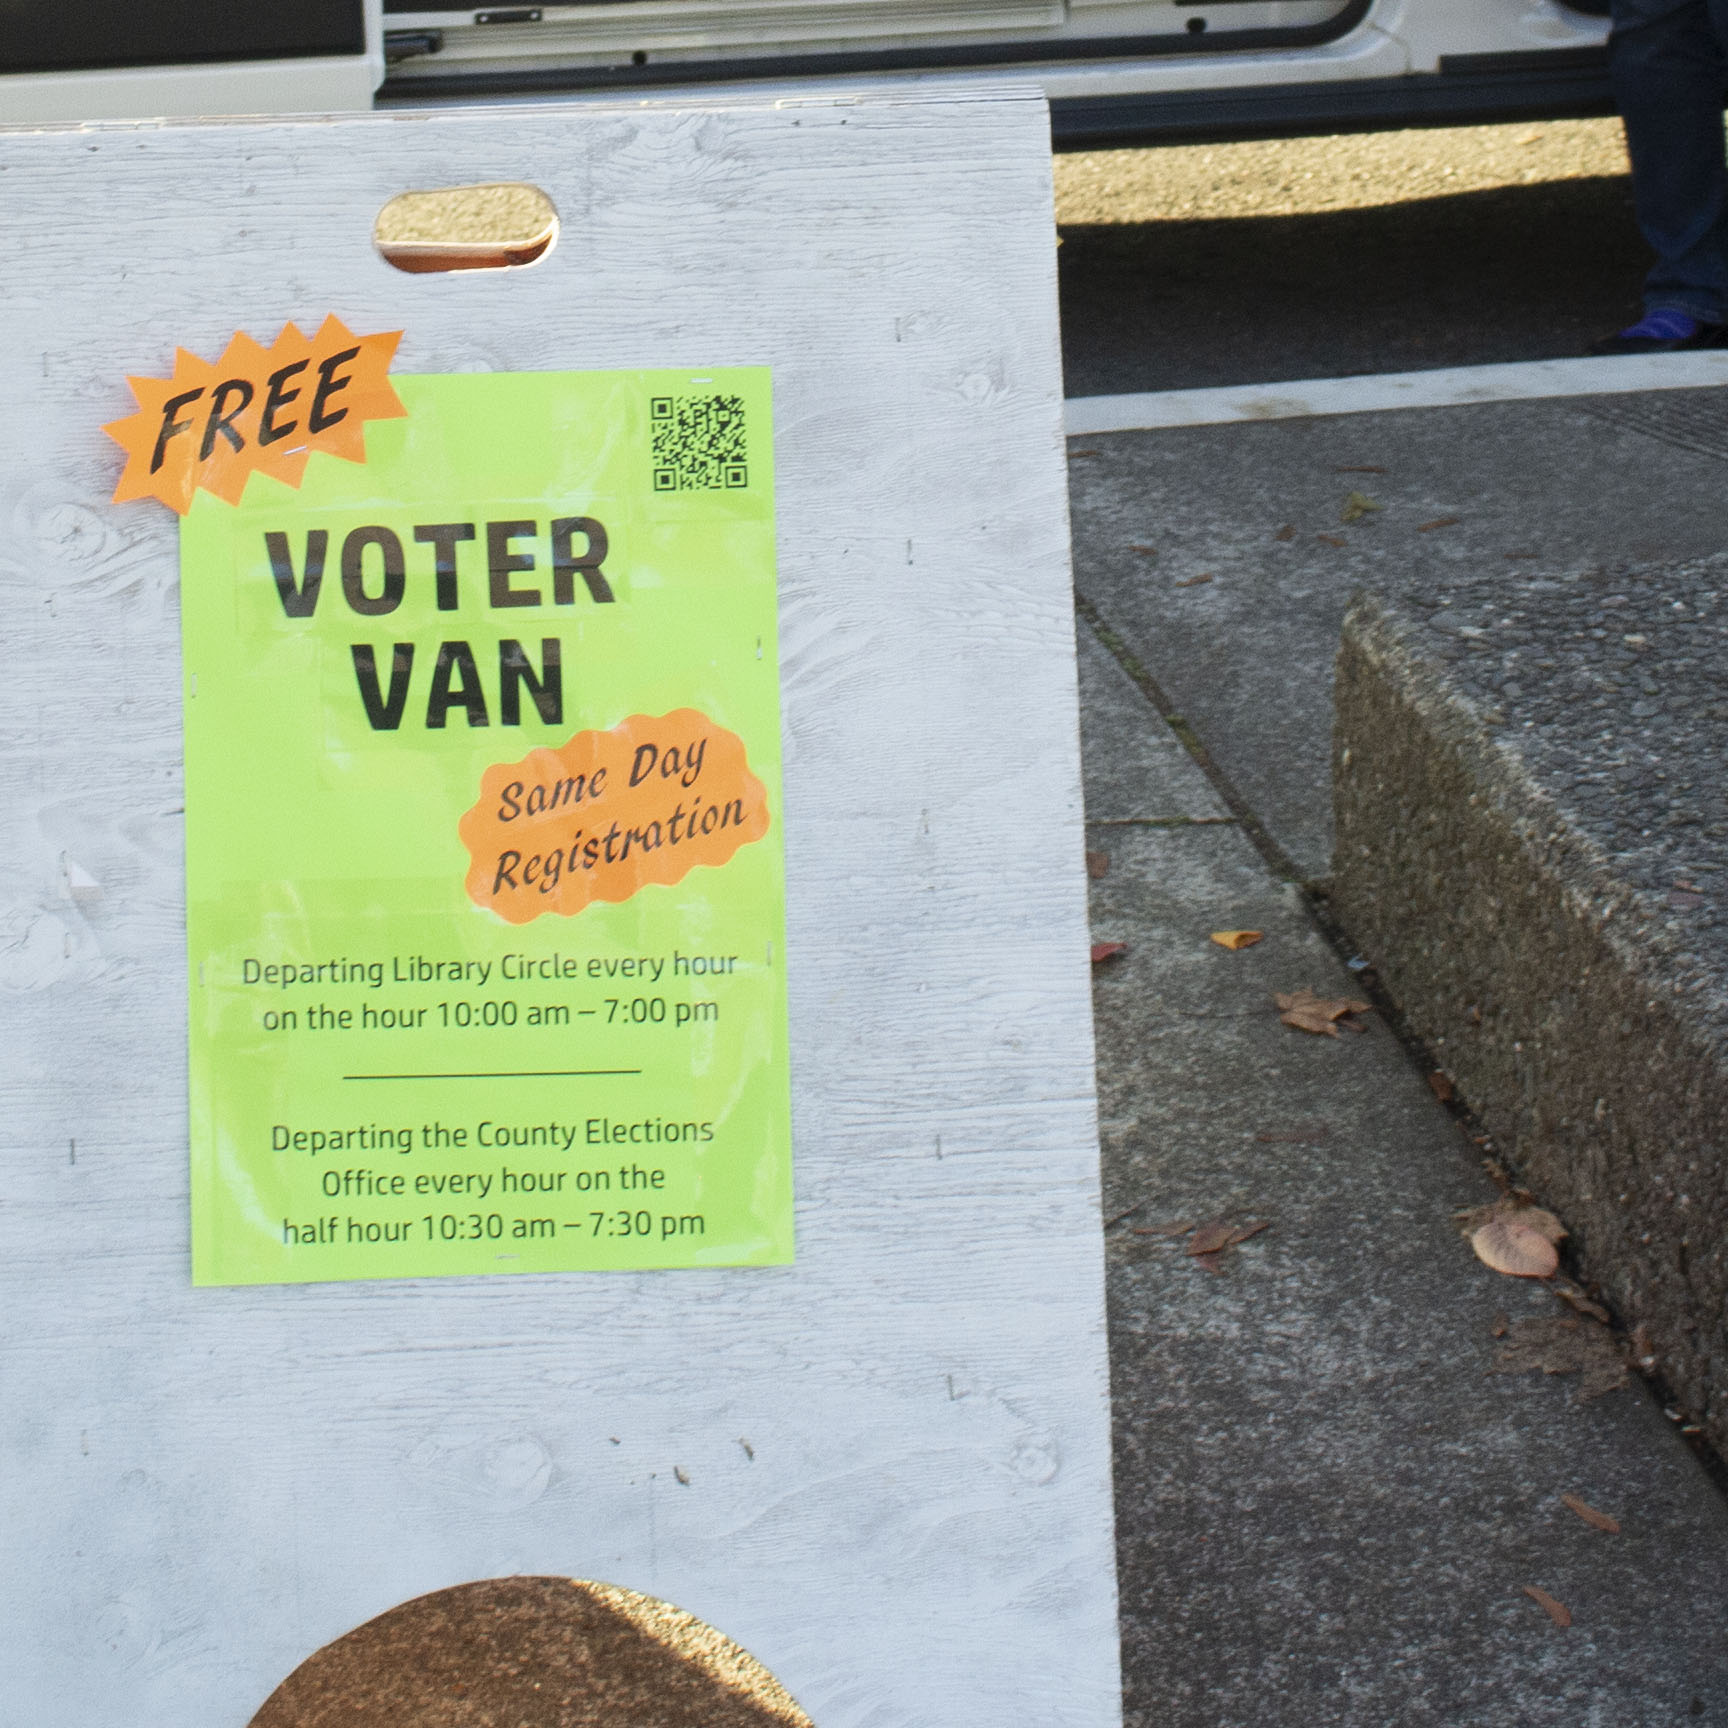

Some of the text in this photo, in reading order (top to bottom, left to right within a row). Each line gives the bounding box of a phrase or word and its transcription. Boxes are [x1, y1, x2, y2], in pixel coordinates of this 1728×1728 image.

[150, 345, 362, 475] FREE
[264, 515, 615, 618] VOTER
[350, 638, 565, 731] VAN
[498, 737, 707, 823] Same Day
[492, 795, 749, 896] Registration
[242, 950, 738, 989] Departing Library Circle every hour
[263, 1010, 297, 1031] on
[307, 1003, 353, 1029] the
[362, 1003, 427, 1029] hour
[439, 1001, 518, 1027] 10:00
[528, 1005, 570, 1025] am
[605, 998, 666, 1024] 7:00
[675, 1001, 719, 1029] pm
[272, 1117, 714, 1154] Departing the County Elections
[322, 1165, 665, 1199] Office every hour on the
[283, 1217, 338, 1245] half
[347, 1216, 412, 1243] hour
[423, 1215, 504, 1241] 10:30
[512, 1218, 556, 1239] am
[589, 1211, 651, 1237] 7:30
[661, 1213, 705, 1241] pm
